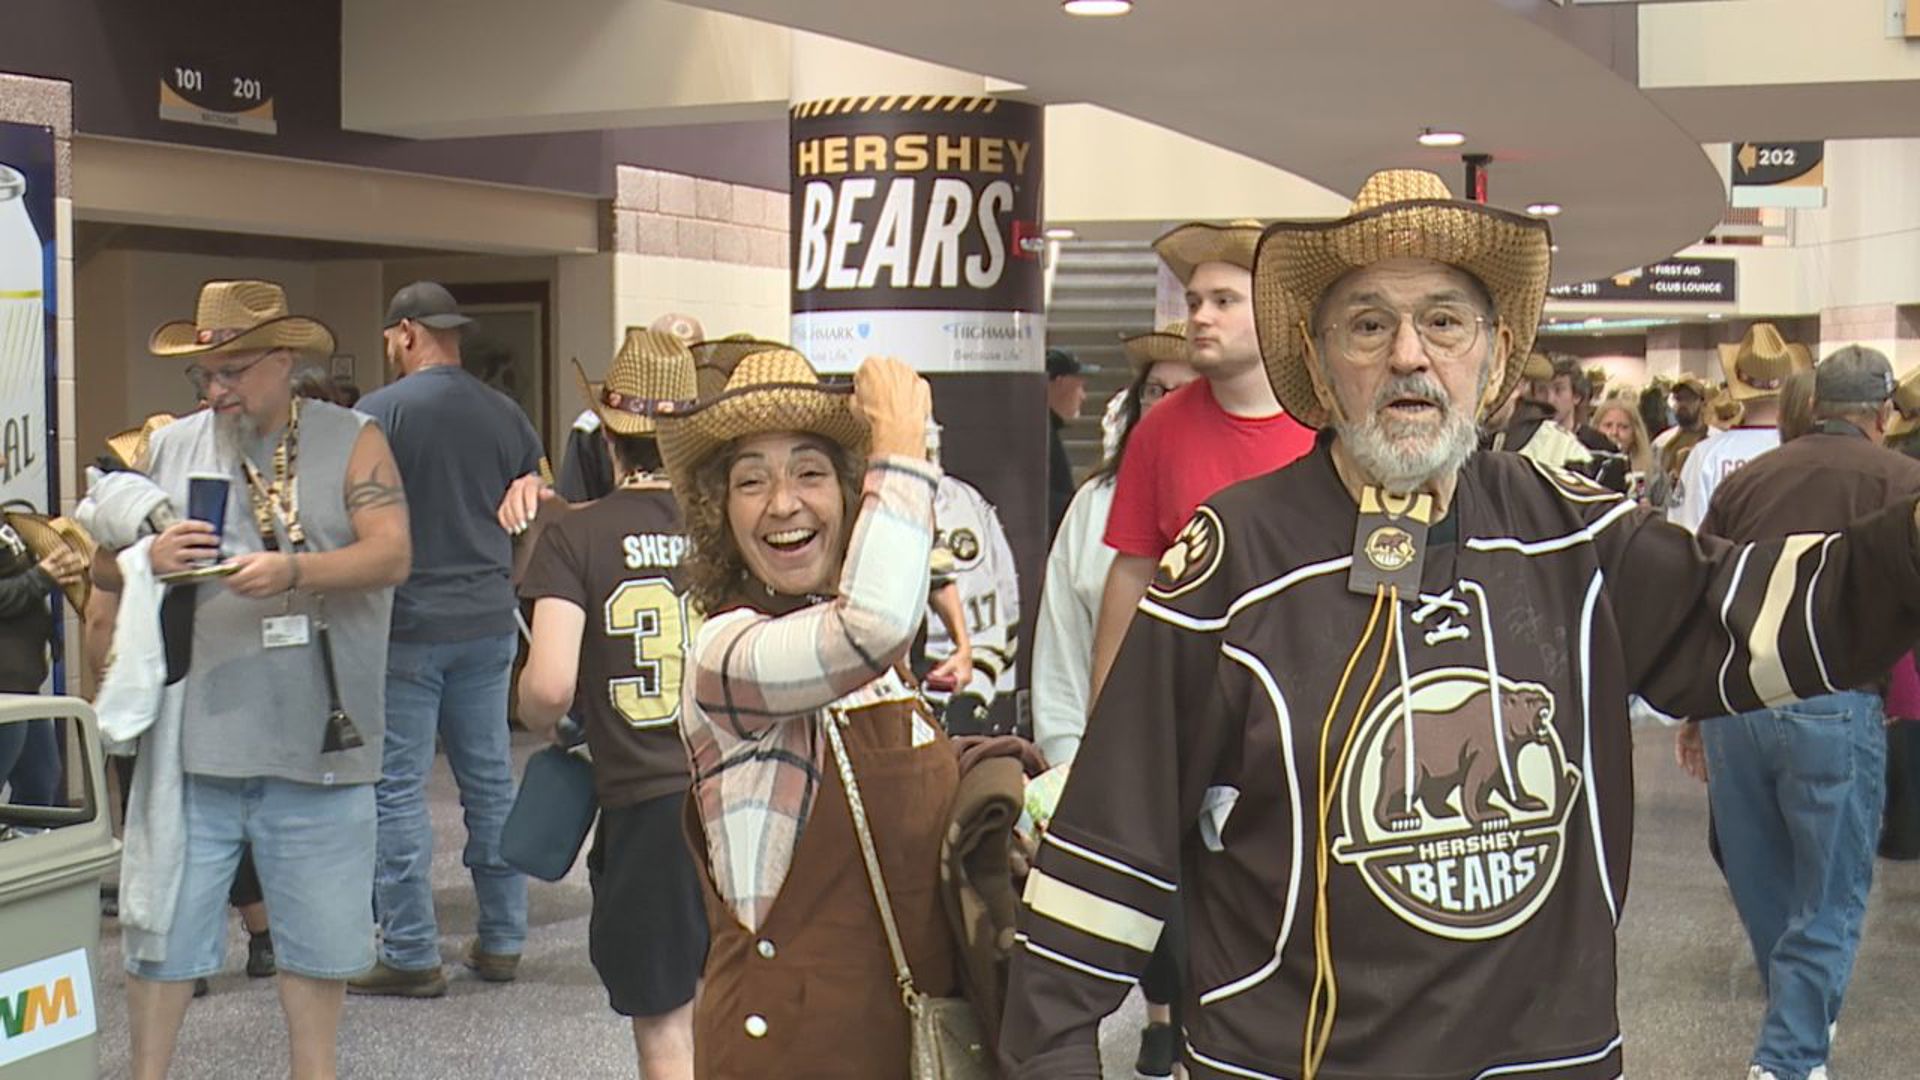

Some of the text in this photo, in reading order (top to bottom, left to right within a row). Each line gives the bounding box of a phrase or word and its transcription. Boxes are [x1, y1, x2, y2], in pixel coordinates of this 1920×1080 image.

[175, 67, 261, 100] 101 201
[798, 134, 1031, 177] HERSHEY
[1758, 149, 1795, 165] 202
[797, 177, 1014, 290] BEARS
[1655, 264, 1701, 275] FIRST AID
[1580, 283, 1597, 295] 211
[1655, 282, 1722, 294] CLUB LOUNGE
[967, 591, 997, 635] 17
[1419, 830, 1522, 860] HERSHEY
[1405, 847, 1537, 912] BEARS
